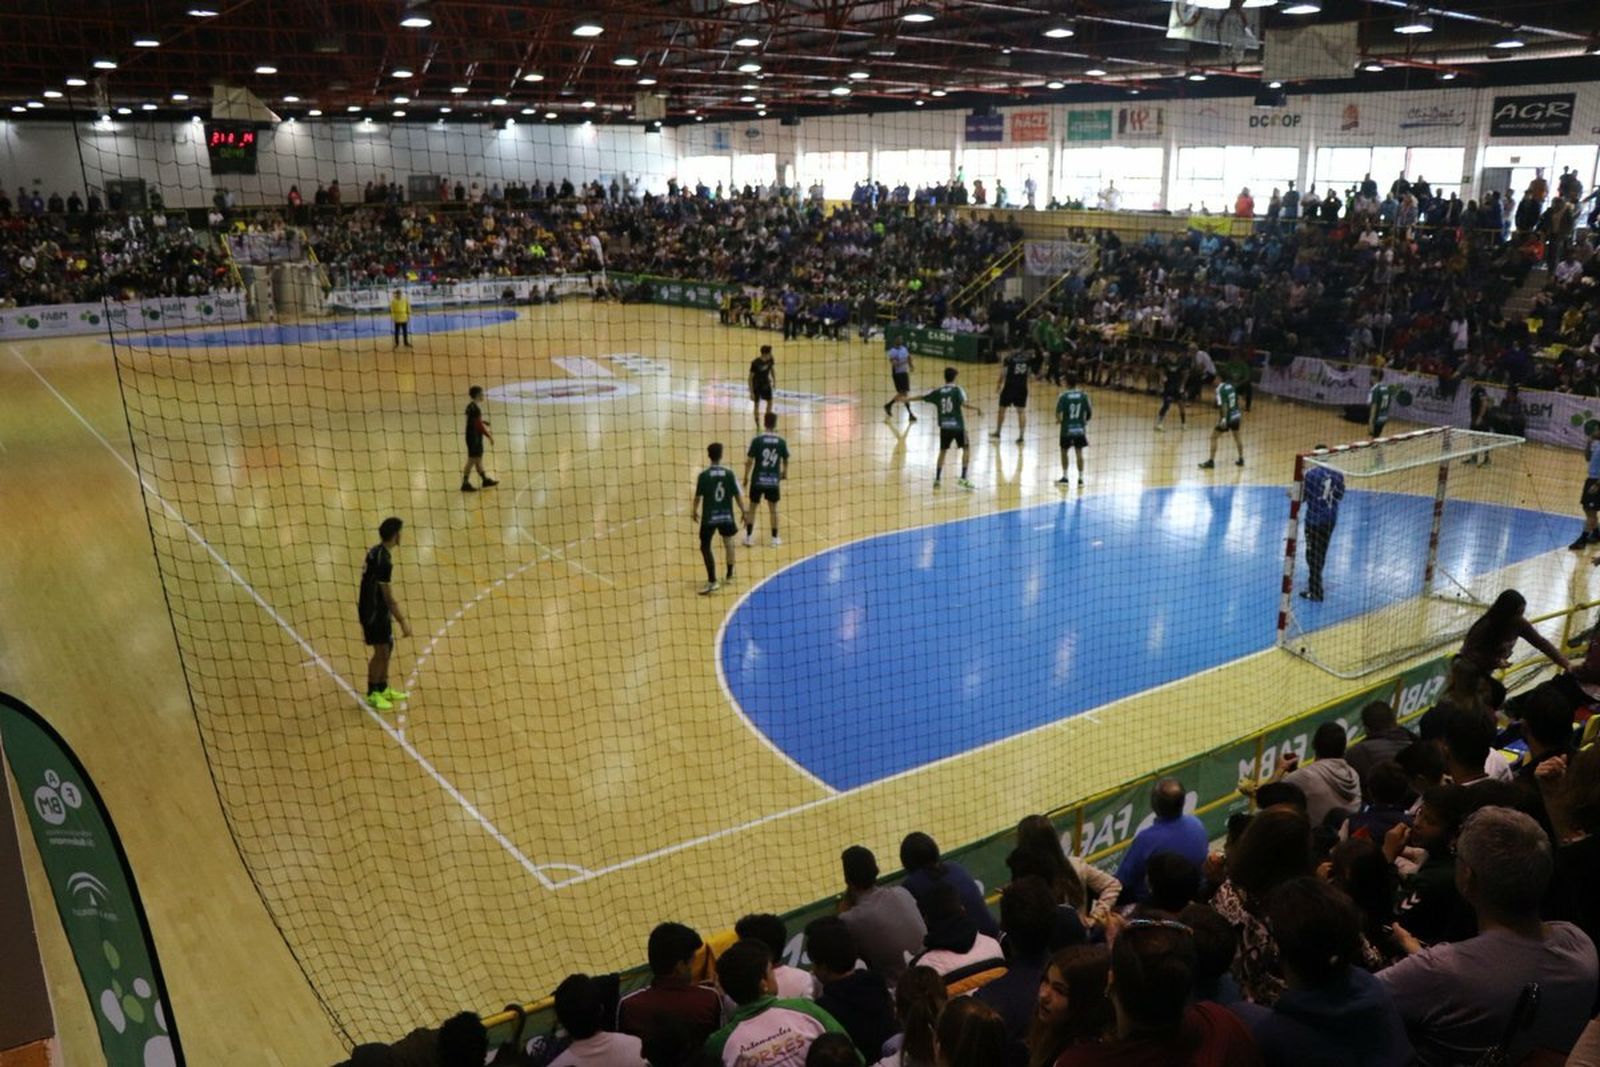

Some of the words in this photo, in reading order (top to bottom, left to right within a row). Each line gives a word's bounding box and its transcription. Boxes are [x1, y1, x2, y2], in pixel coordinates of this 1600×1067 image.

[1495, 102, 1571, 120] AGR
[40, 311, 68, 321] FABM
[762, 448, 778, 467] 24
[715, 481, 725, 502] 6
